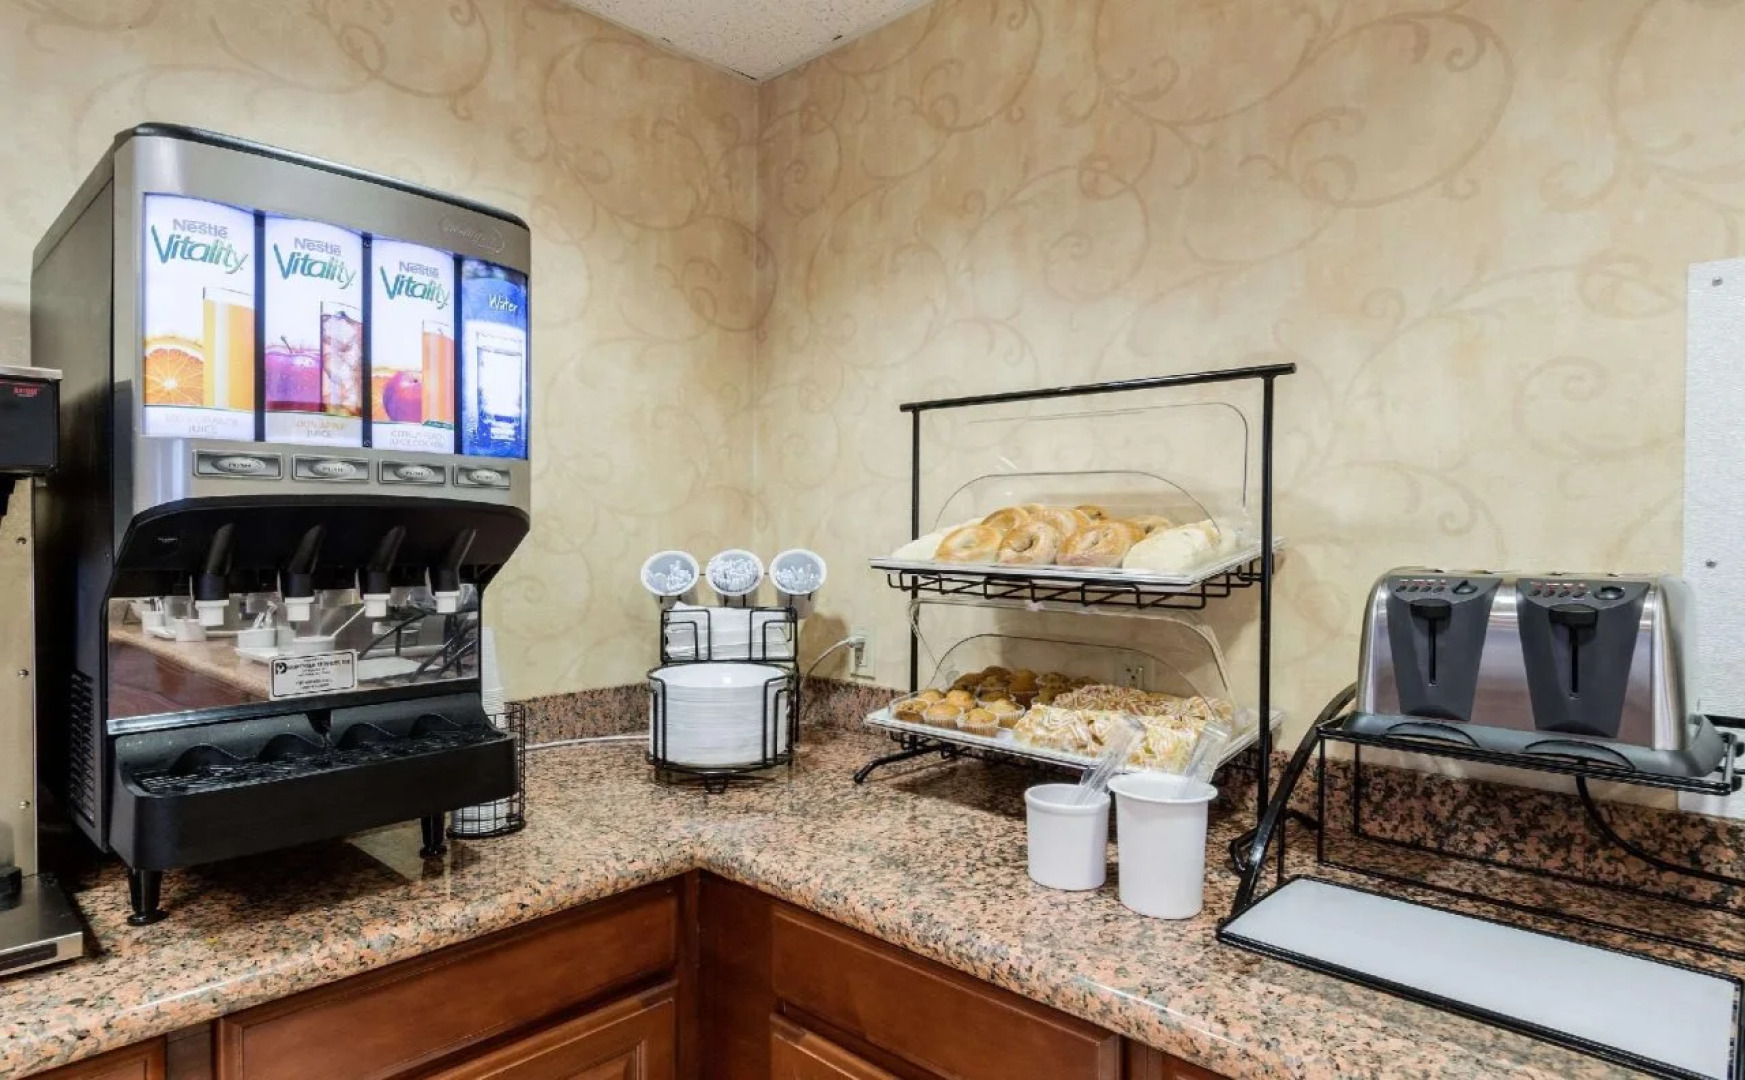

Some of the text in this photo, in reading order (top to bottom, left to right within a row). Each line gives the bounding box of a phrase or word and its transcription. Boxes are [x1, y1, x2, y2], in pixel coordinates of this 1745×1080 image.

[151, 225, 249, 275] Vitality
[273, 243, 357, 290] Vitality
[379, 265, 449, 310] Vitality
[488, 294, 519, 314] Water
